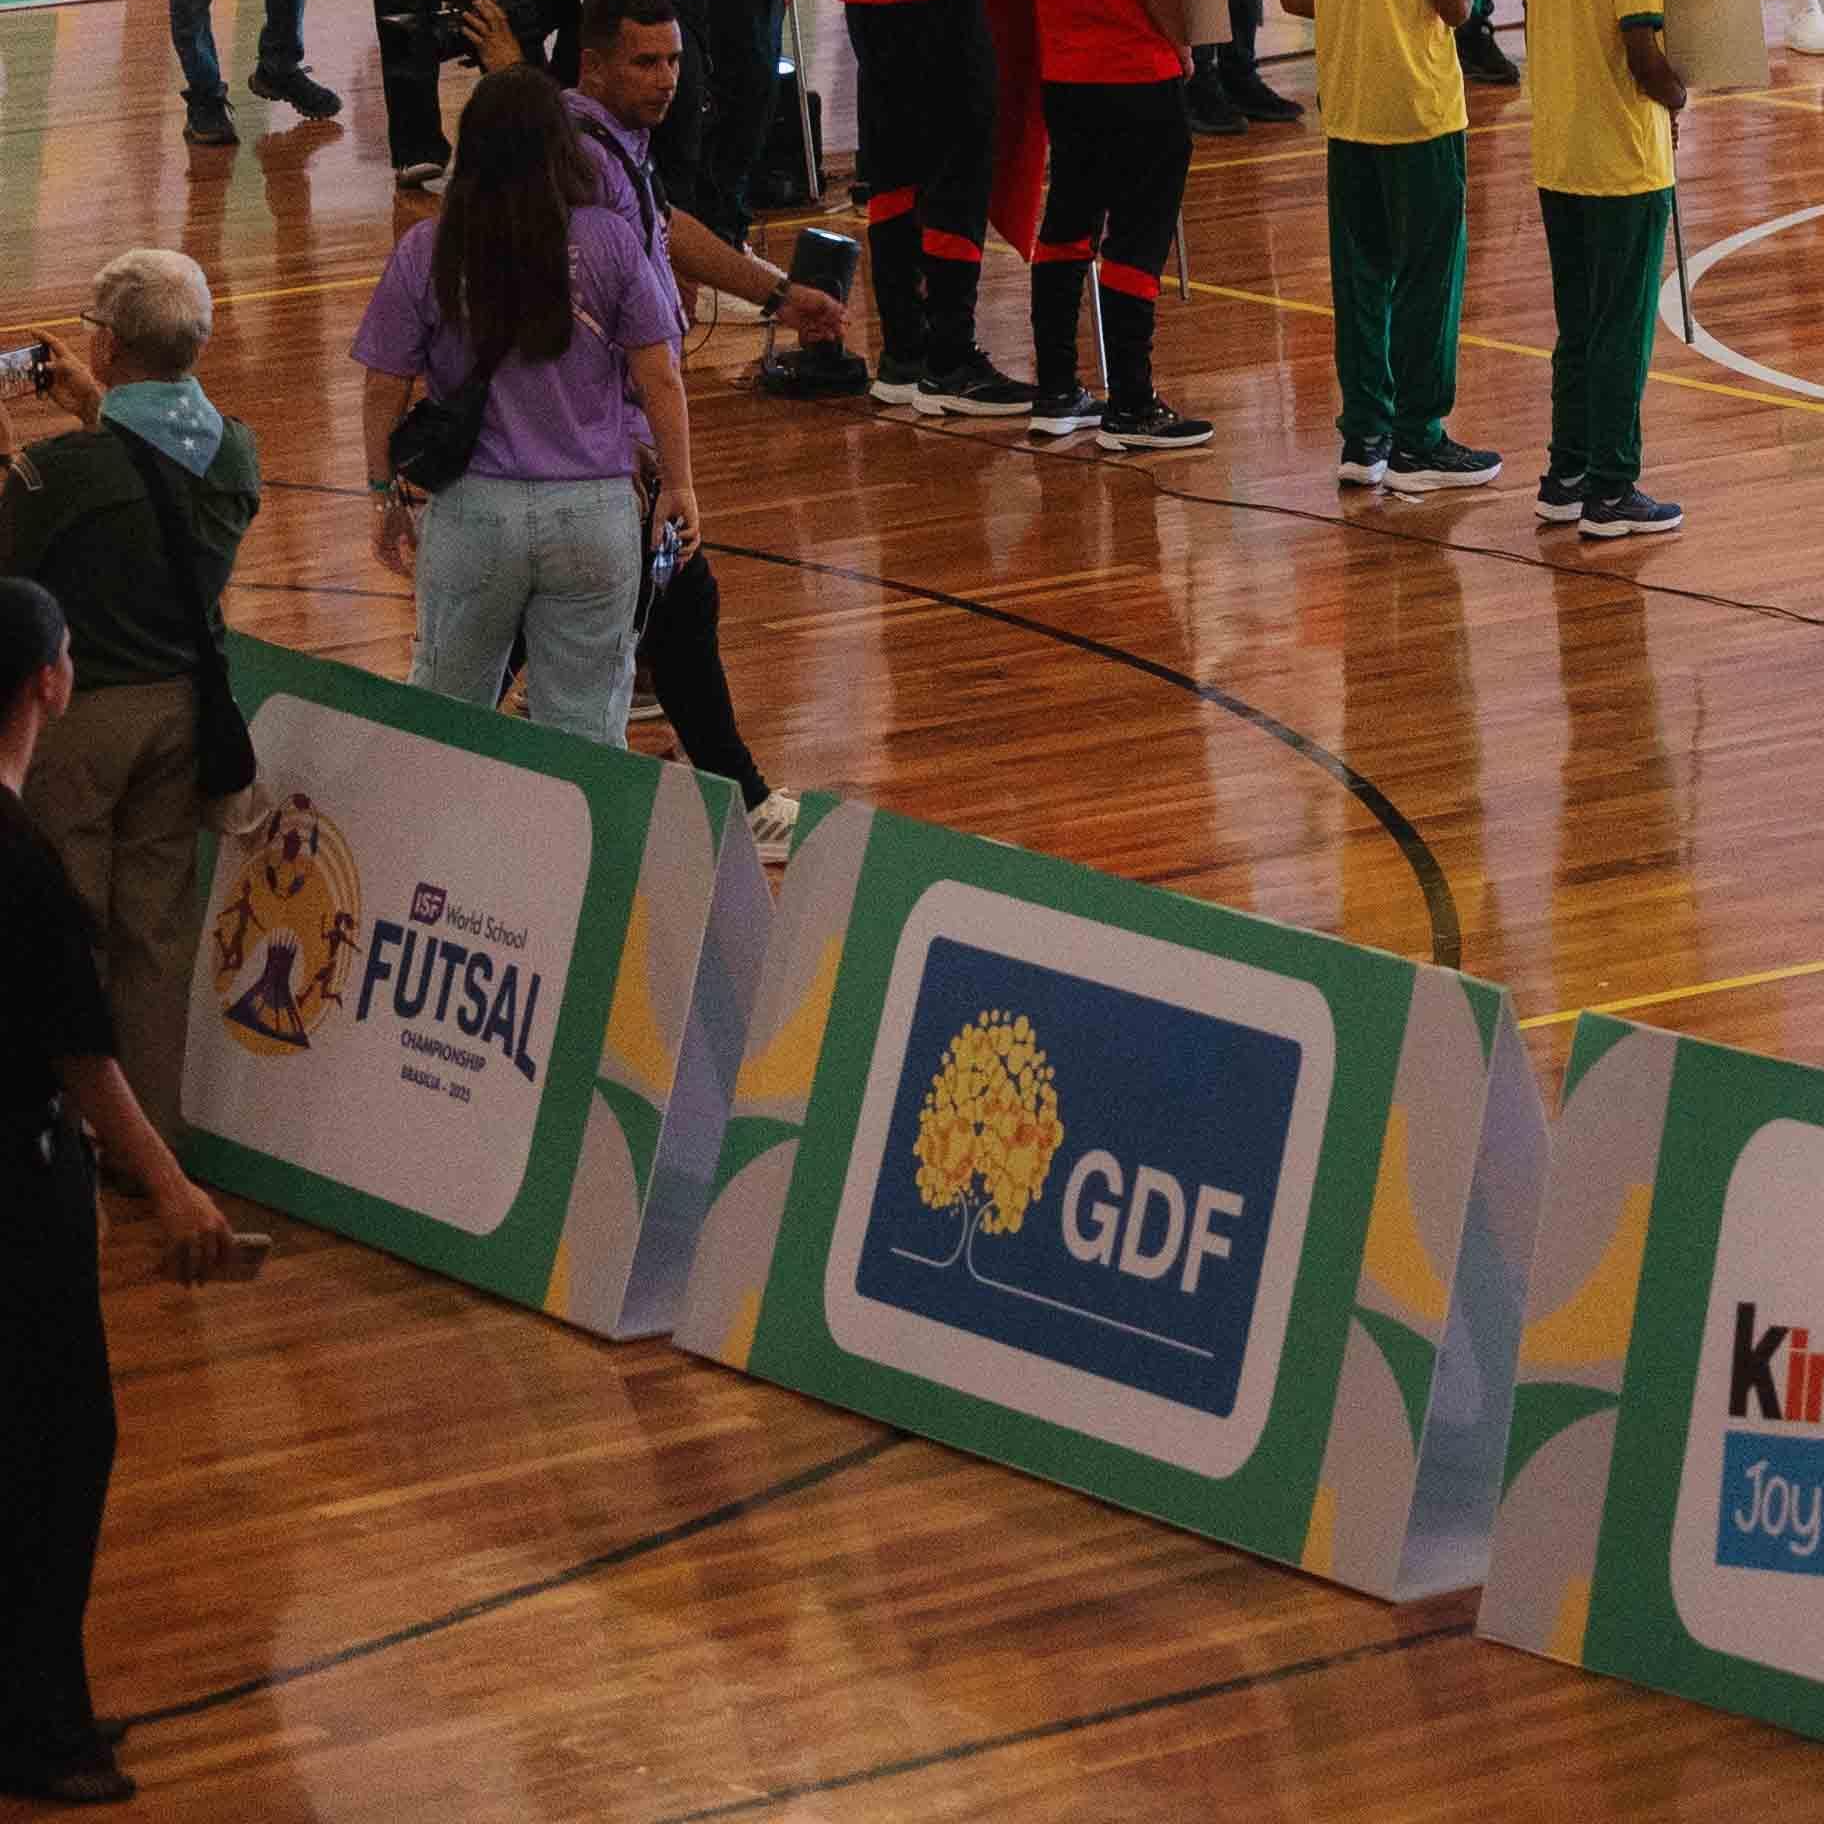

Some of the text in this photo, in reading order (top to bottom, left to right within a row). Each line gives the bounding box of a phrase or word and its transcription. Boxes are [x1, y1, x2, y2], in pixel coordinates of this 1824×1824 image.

[447, 903, 483, 936] World
[486, 916, 528, 949] School
[356, 919, 541, 1083] FUTSAL
[400, 1029, 487, 1073] CHAMPIONSHIP
[1061, 1149, 1246, 1295] GDF
[1734, 1460, 1822, 1556] Joy
